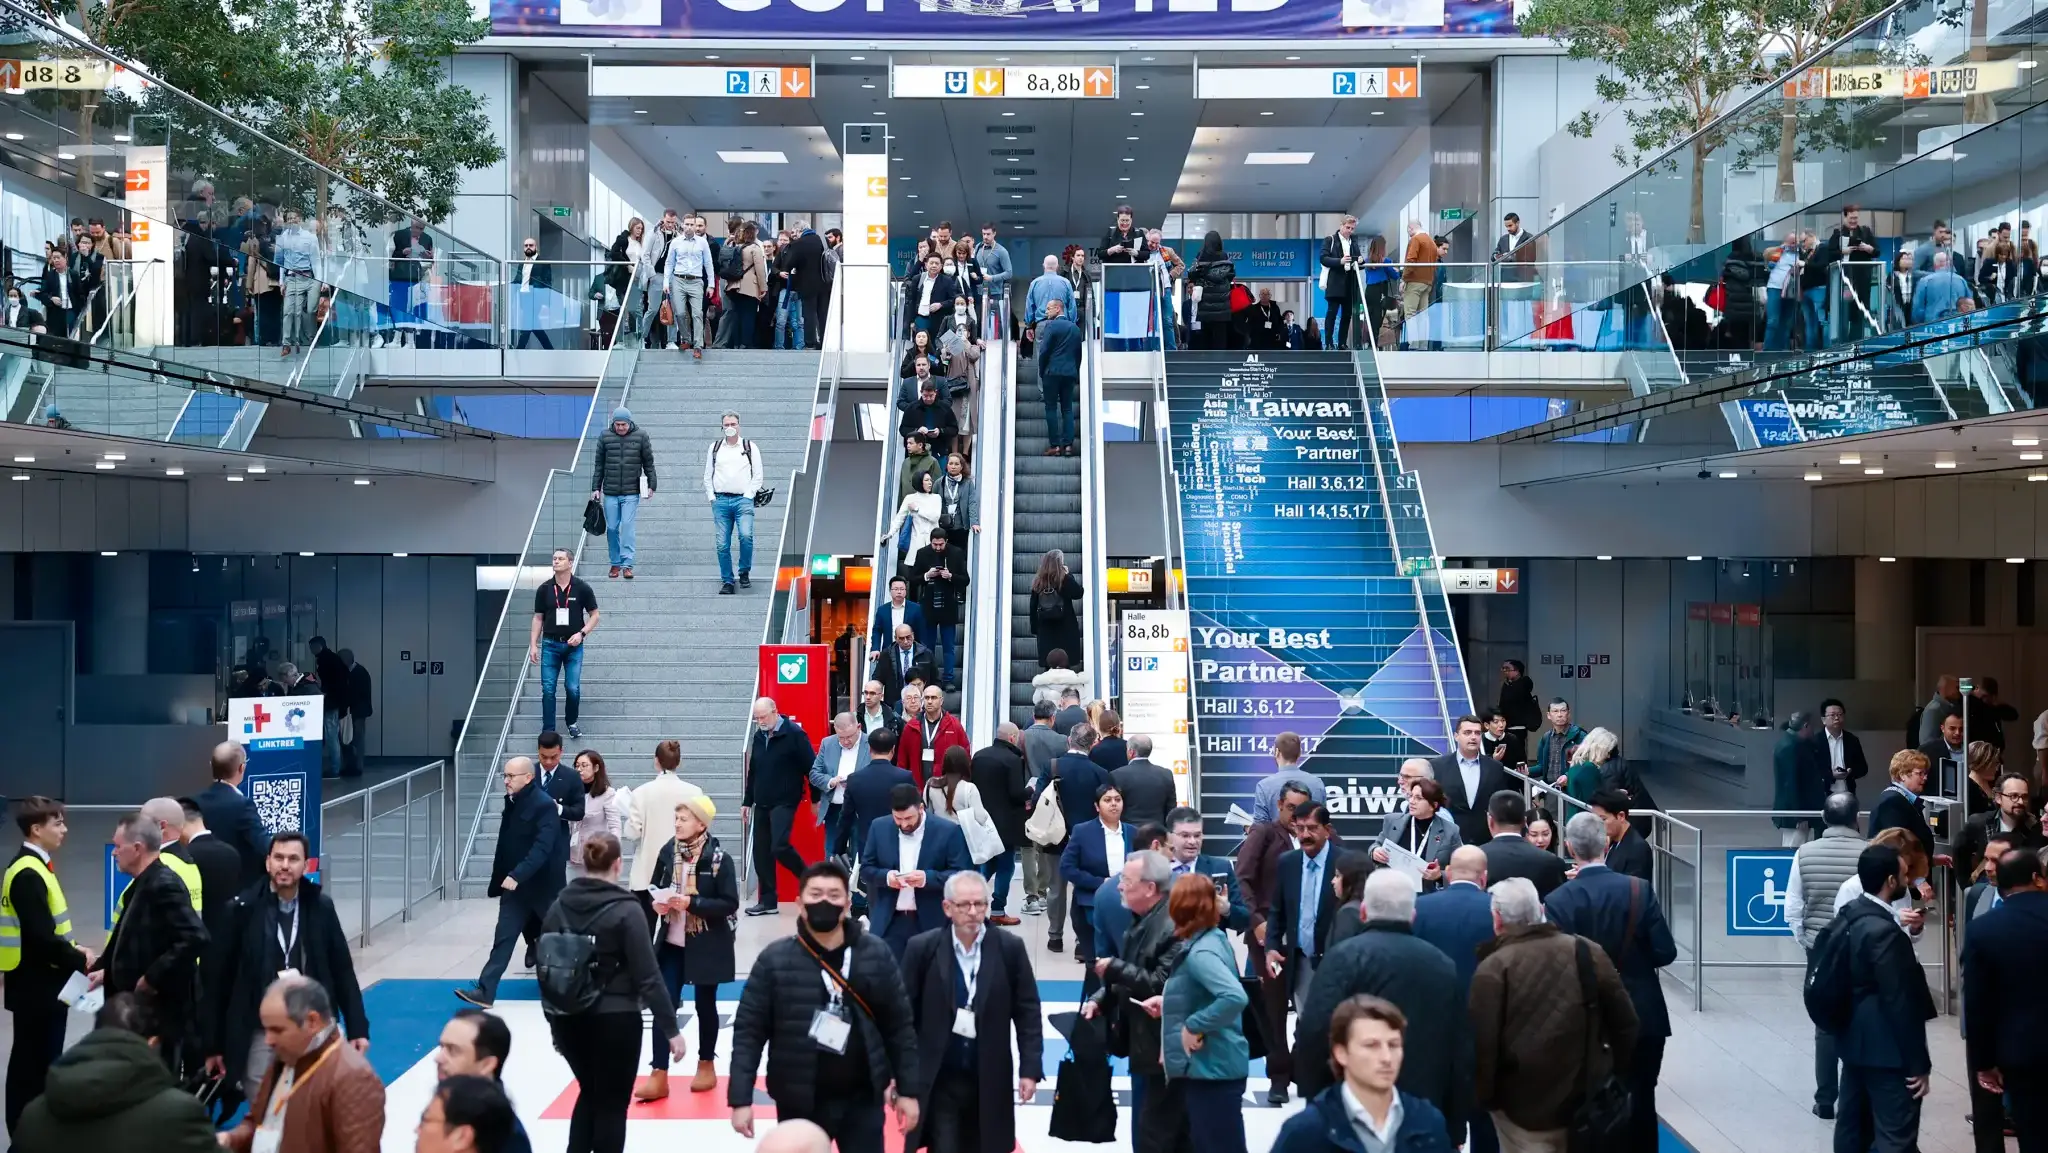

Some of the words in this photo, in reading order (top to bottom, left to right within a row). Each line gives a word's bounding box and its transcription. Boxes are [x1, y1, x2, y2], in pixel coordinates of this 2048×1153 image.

[1027, 72, 1080, 93] 8a,8b
[1251, 251, 1277, 260] Hall17
[1279, 251, 1295, 260] C16
[1246, 354, 1259, 363] AI
[1222, 378, 1240, 387] IoT
[1203, 399, 1228, 408] Asia
[1244, 398, 1352, 417] Taiwan
[1273, 427, 1311, 440] Your
[1316, 427, 1357, 440] Best
[1191, 423, 1204, 489] Diagnostics
[1296, 446, 1359, 460] Partner
[1236, 464, 1260, 473] Med
[1237, 474, 1266, 483] Tech
[1288, 477, 1315, 489] Hall
[1321, 477, 1364, 491] 3,6,12
[1275, 505, 1303, 517] Hall
[1309, 505, 1370, 519] 14,15,17
[1222, 522, 1235, 574] Hospital
[1232, 522, 1245, 560] Smart
[1127, 613, 1146, 621] Halle
[1128, 624, 1169, 640] 8a,8b
[1197, 627, 1260, 649] Your
[1268, 628, 1333, 649] Best
[1200, 659, 1306, 683] Partner
[1204, 699, 1237, 714] Hall
[1243, 699, 1295, 718] 3,6,12
[258, 739, 295, 749] LINKTREE
[1207, 736, 1241, 752] Hall
